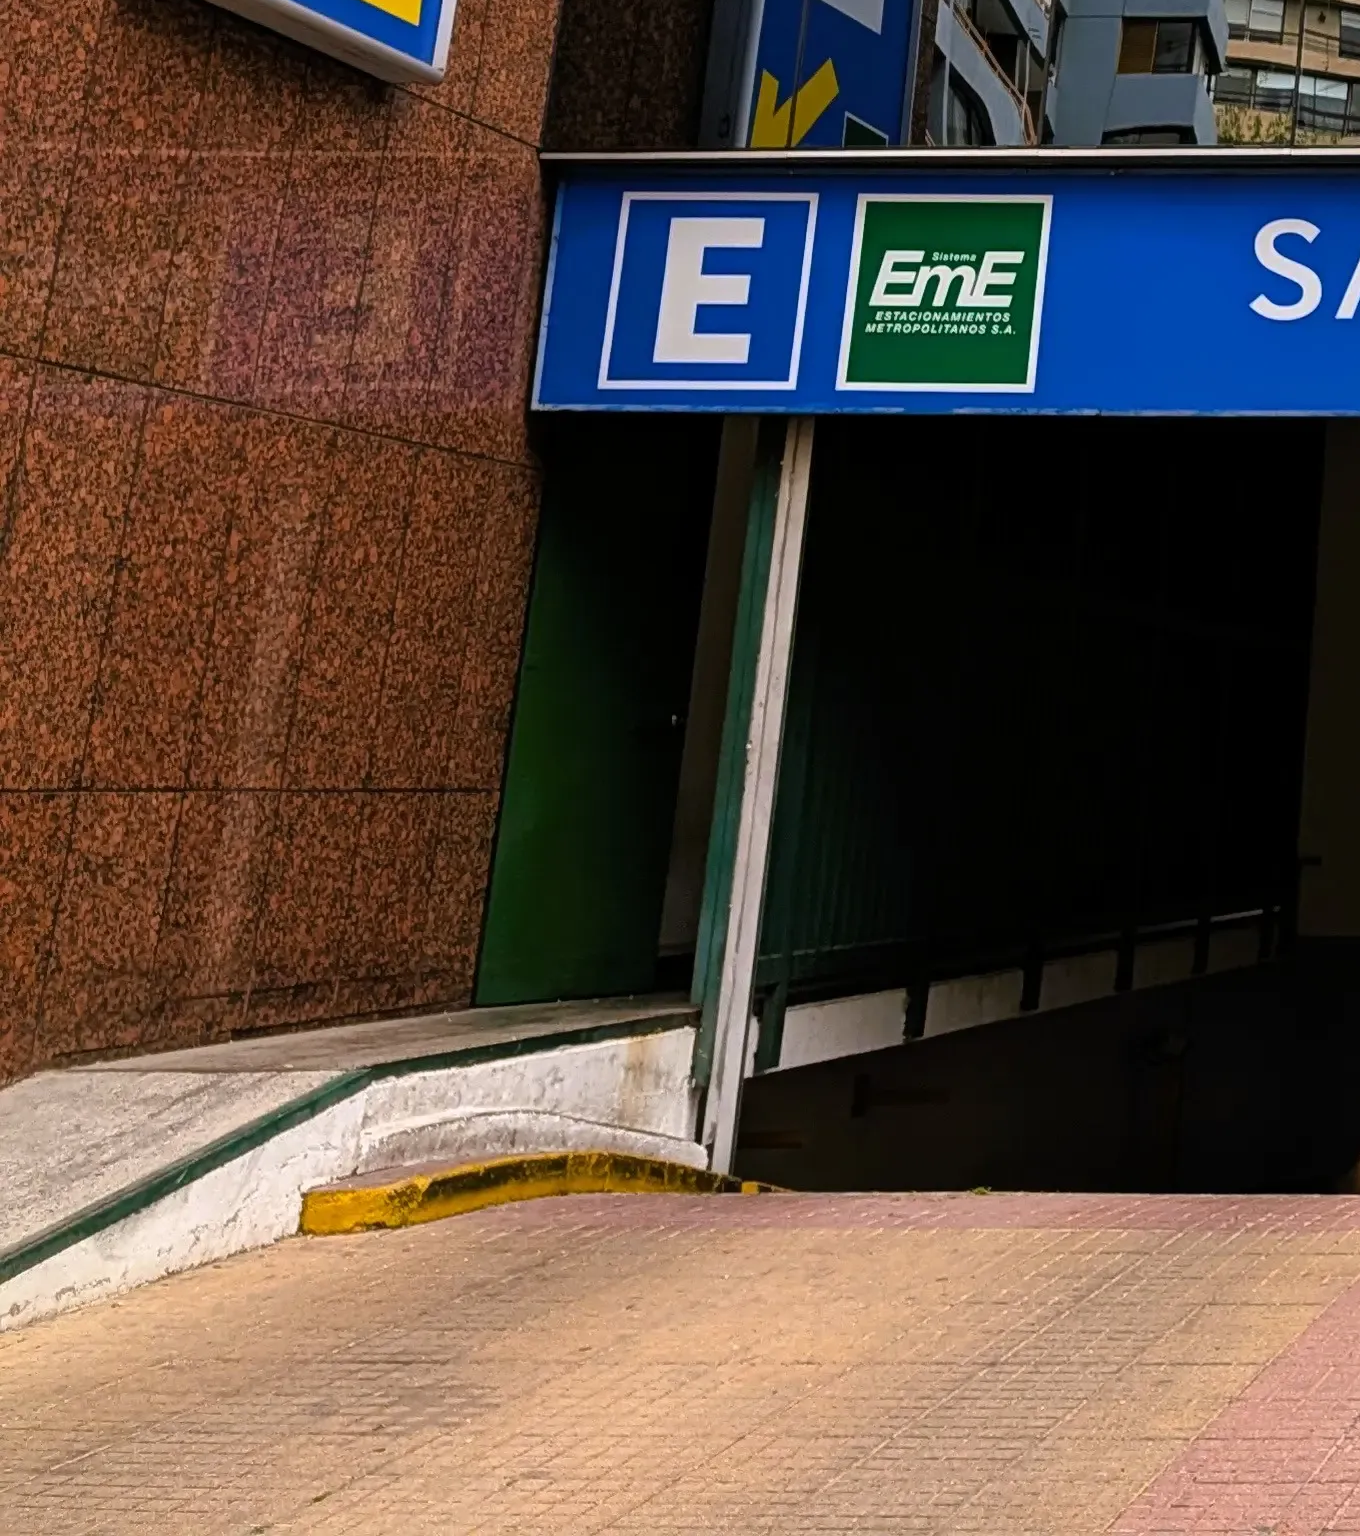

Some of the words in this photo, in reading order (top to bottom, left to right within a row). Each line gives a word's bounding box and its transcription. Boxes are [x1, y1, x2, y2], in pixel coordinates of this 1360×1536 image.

[932, 252, 977, 262] Sistema
[653, 218, 764, 363] E
[875, 311, 1011, 323] ESTACIONAMIENTOS
[865, 323, 986, 335] METROPOLITANOS
[990, 324, 1017, 335] S.A.
